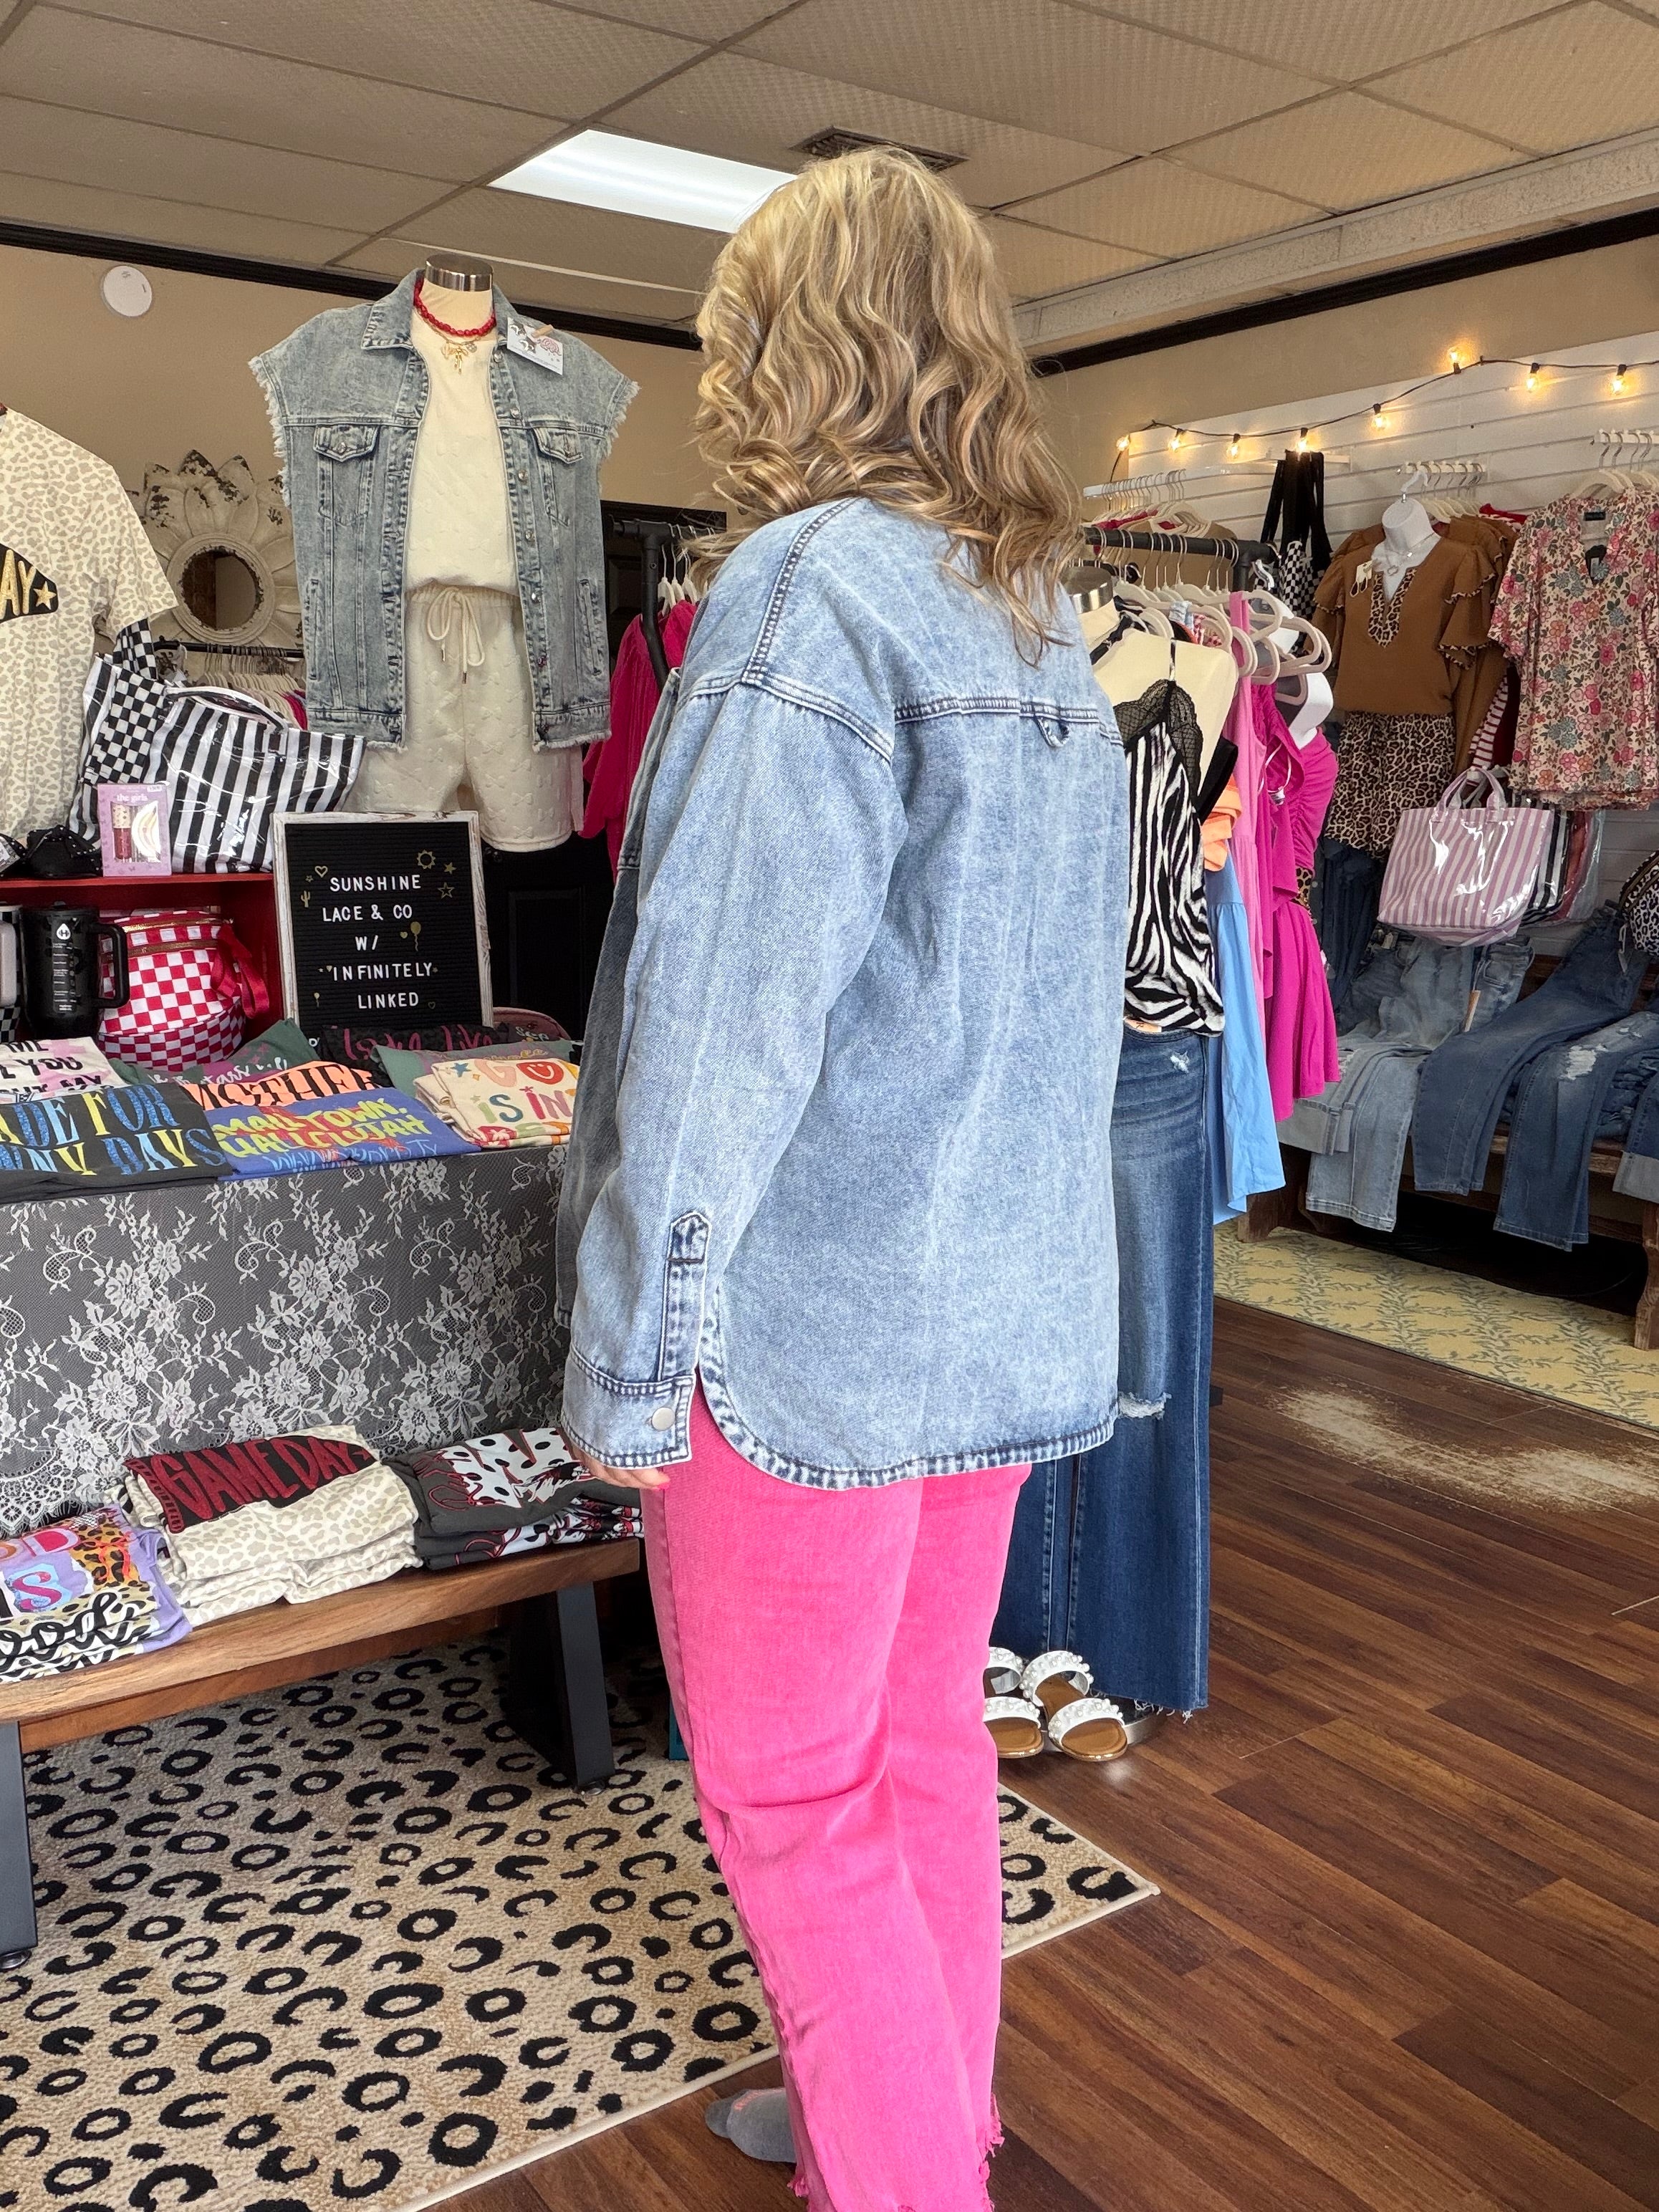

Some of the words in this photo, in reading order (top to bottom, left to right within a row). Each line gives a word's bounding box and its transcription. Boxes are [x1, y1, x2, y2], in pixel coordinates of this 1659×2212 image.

[330, 874, 421, 892] SUNSHINE
[322, 905, 363, 922] LACE
[371, 904, 383, 920] &
[393, 904, 413, 919] CO
[355, 935, 378, 951] W/
[333, 962, 432, 981] INFINITELY
[357, 991, 419, 1009] LINKED
[12, 1057, 84, 1076] YOU
[81, 1084, 181, 1136] FOR
[100, 1128, 228, 1175] DAYS
